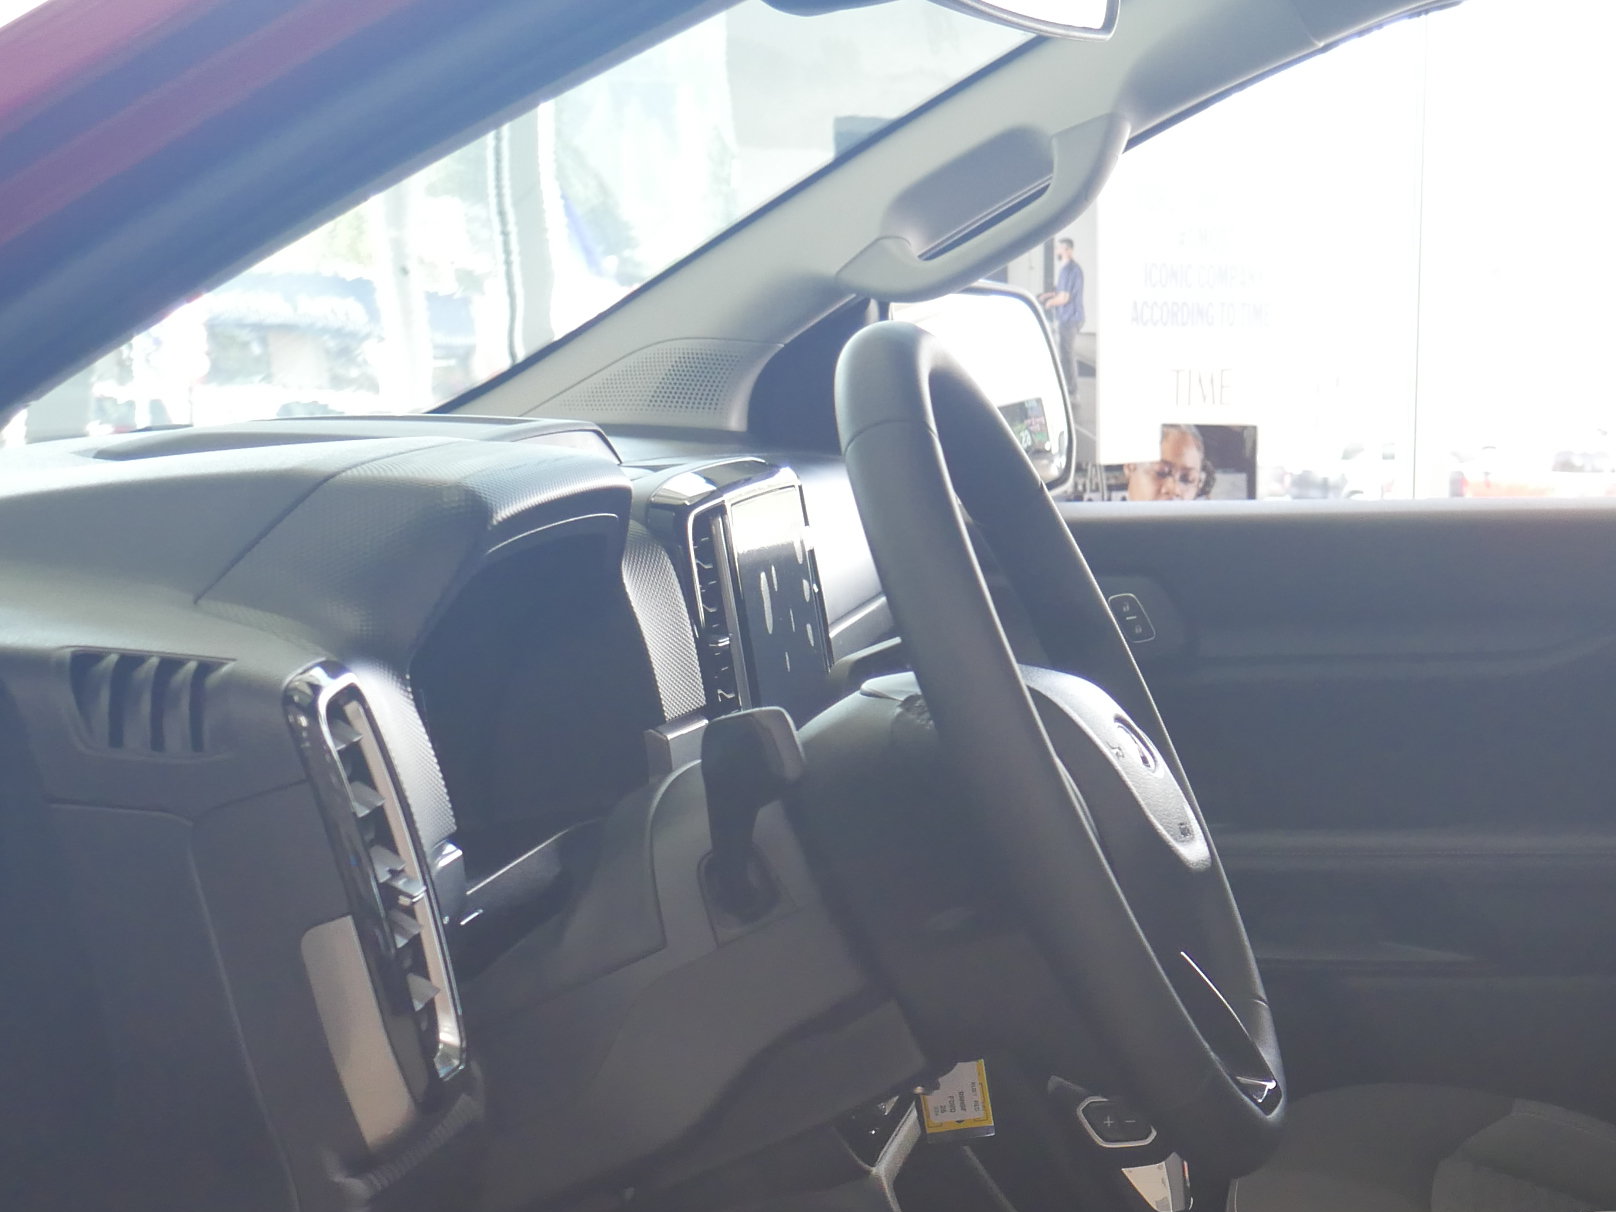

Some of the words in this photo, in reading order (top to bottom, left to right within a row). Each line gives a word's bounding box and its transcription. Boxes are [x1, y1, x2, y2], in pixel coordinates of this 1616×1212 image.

[1143, 262, 1193, 288] ICONIC
[1130, 299, 1215, 327] ACCORDING
[1219, 302, 1237, 327] TO
[1171, 368, 1233, 406] TIME
